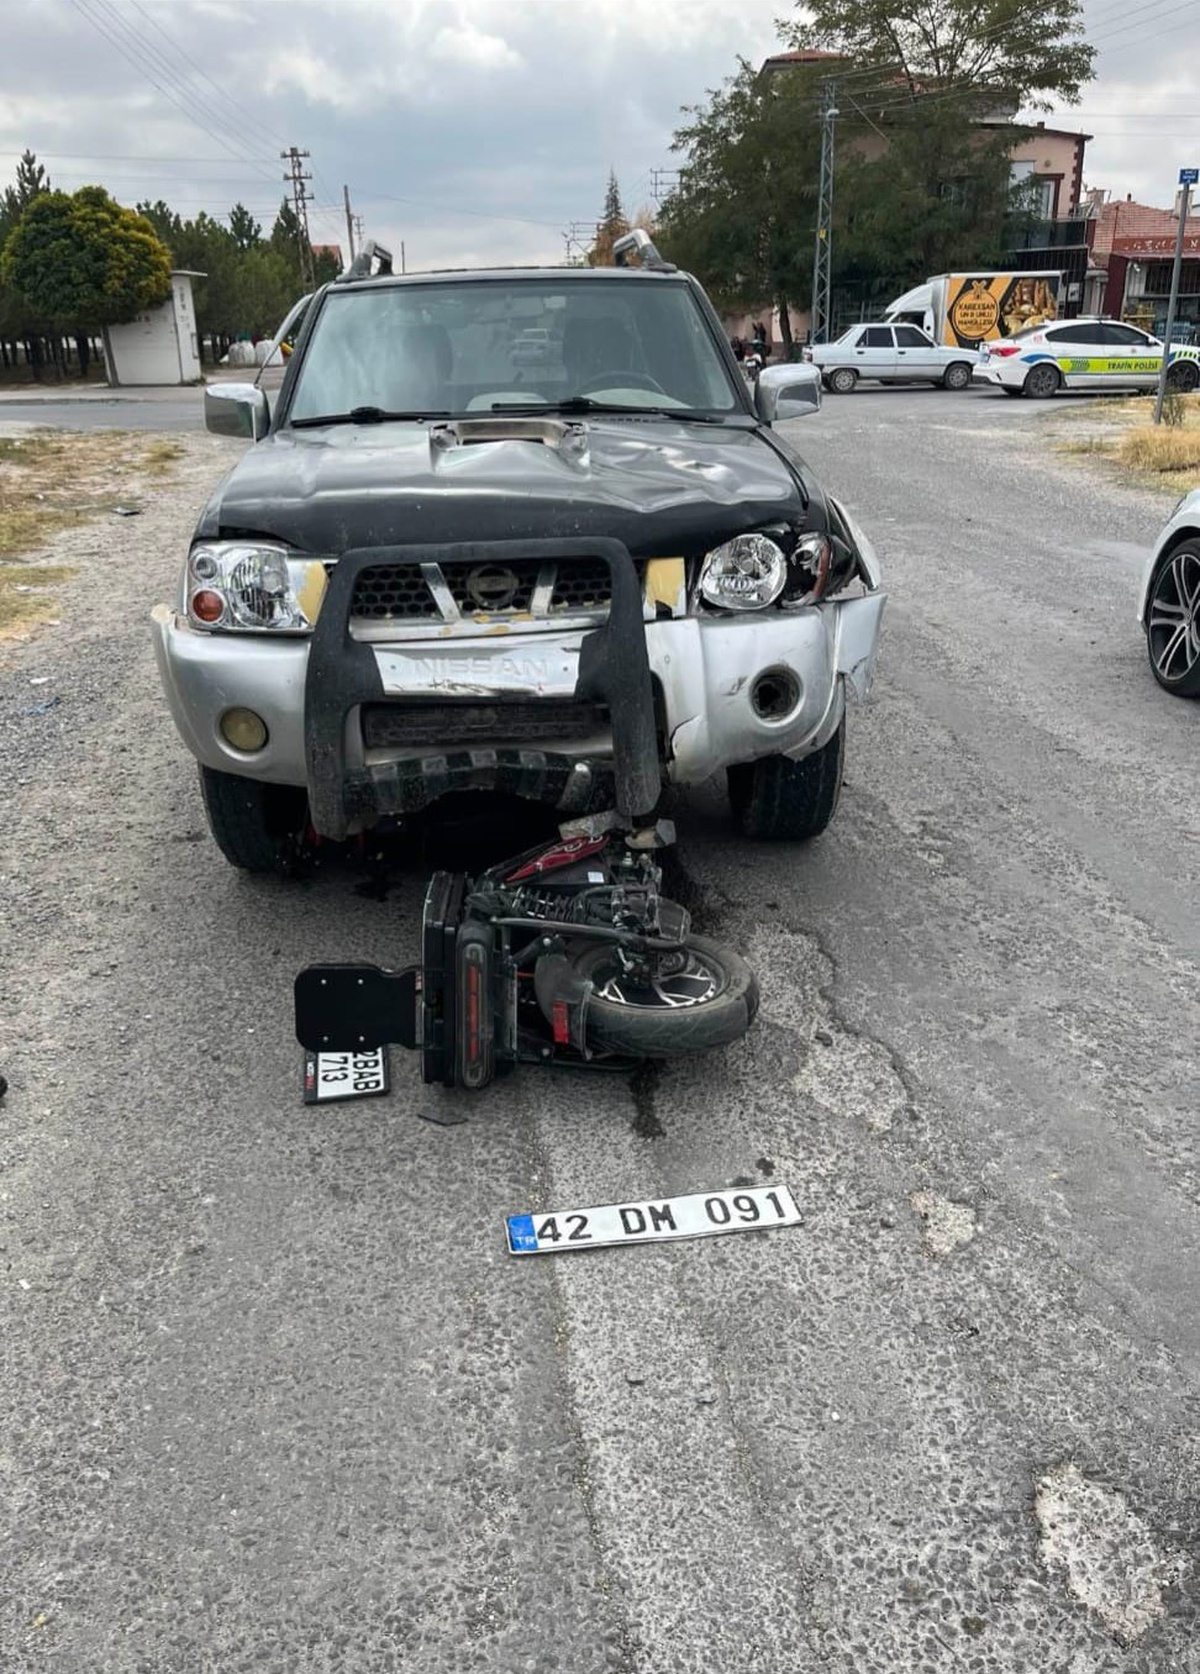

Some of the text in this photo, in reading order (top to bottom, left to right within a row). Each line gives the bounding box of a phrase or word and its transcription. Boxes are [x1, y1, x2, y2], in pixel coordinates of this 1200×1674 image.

[414, 658, 548, 676] NISSAN
[321, 1056, 349, 1083] 713
[537, 1191, 786, 1243] 42 DM 091
[515, 1235, 536, 1246] TR
